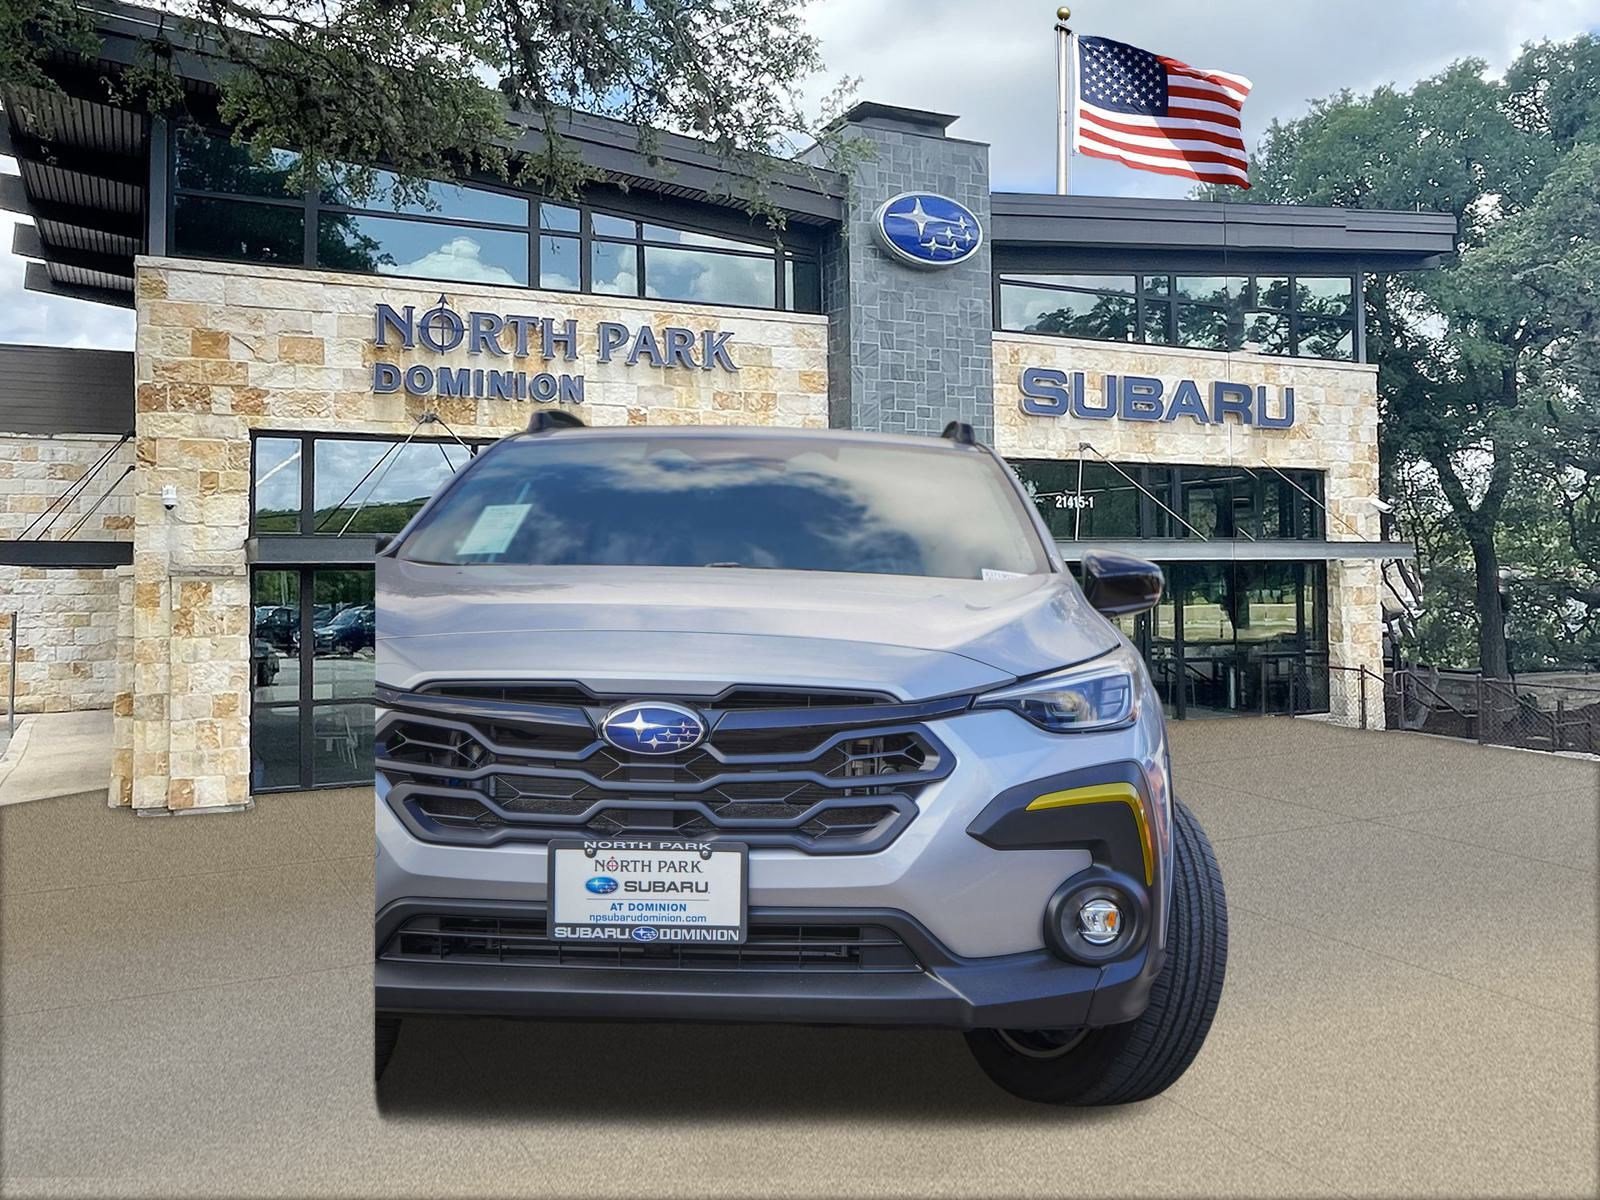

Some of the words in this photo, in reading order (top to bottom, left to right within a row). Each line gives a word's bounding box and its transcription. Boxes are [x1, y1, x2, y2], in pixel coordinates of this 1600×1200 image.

[375, 294, 579, 361] NORTH
[597, 321, 741, 373] PARK
[373, 363, 585, 404] DOMINION
[1018, 367, 1295, 430] SUBARU
[1055, 495, 1094, 509] 21415-1
[584, 841, 651, 850] NORTH
[659, 842, 712, 851] PARK
[594, 857, 652, 873] NORTH
[657, 860, 704, 873] PARK
[624, 881, 709, 894] SUBARU
[610, 903, 624, 912] AT
[628, 903, 687, 912] DOMINION
[589, 913, 707, 923] npsubarudominion.com
[554, 926, 629, 939] SUBARU
[659, 928, 739, 941] DOMINION
